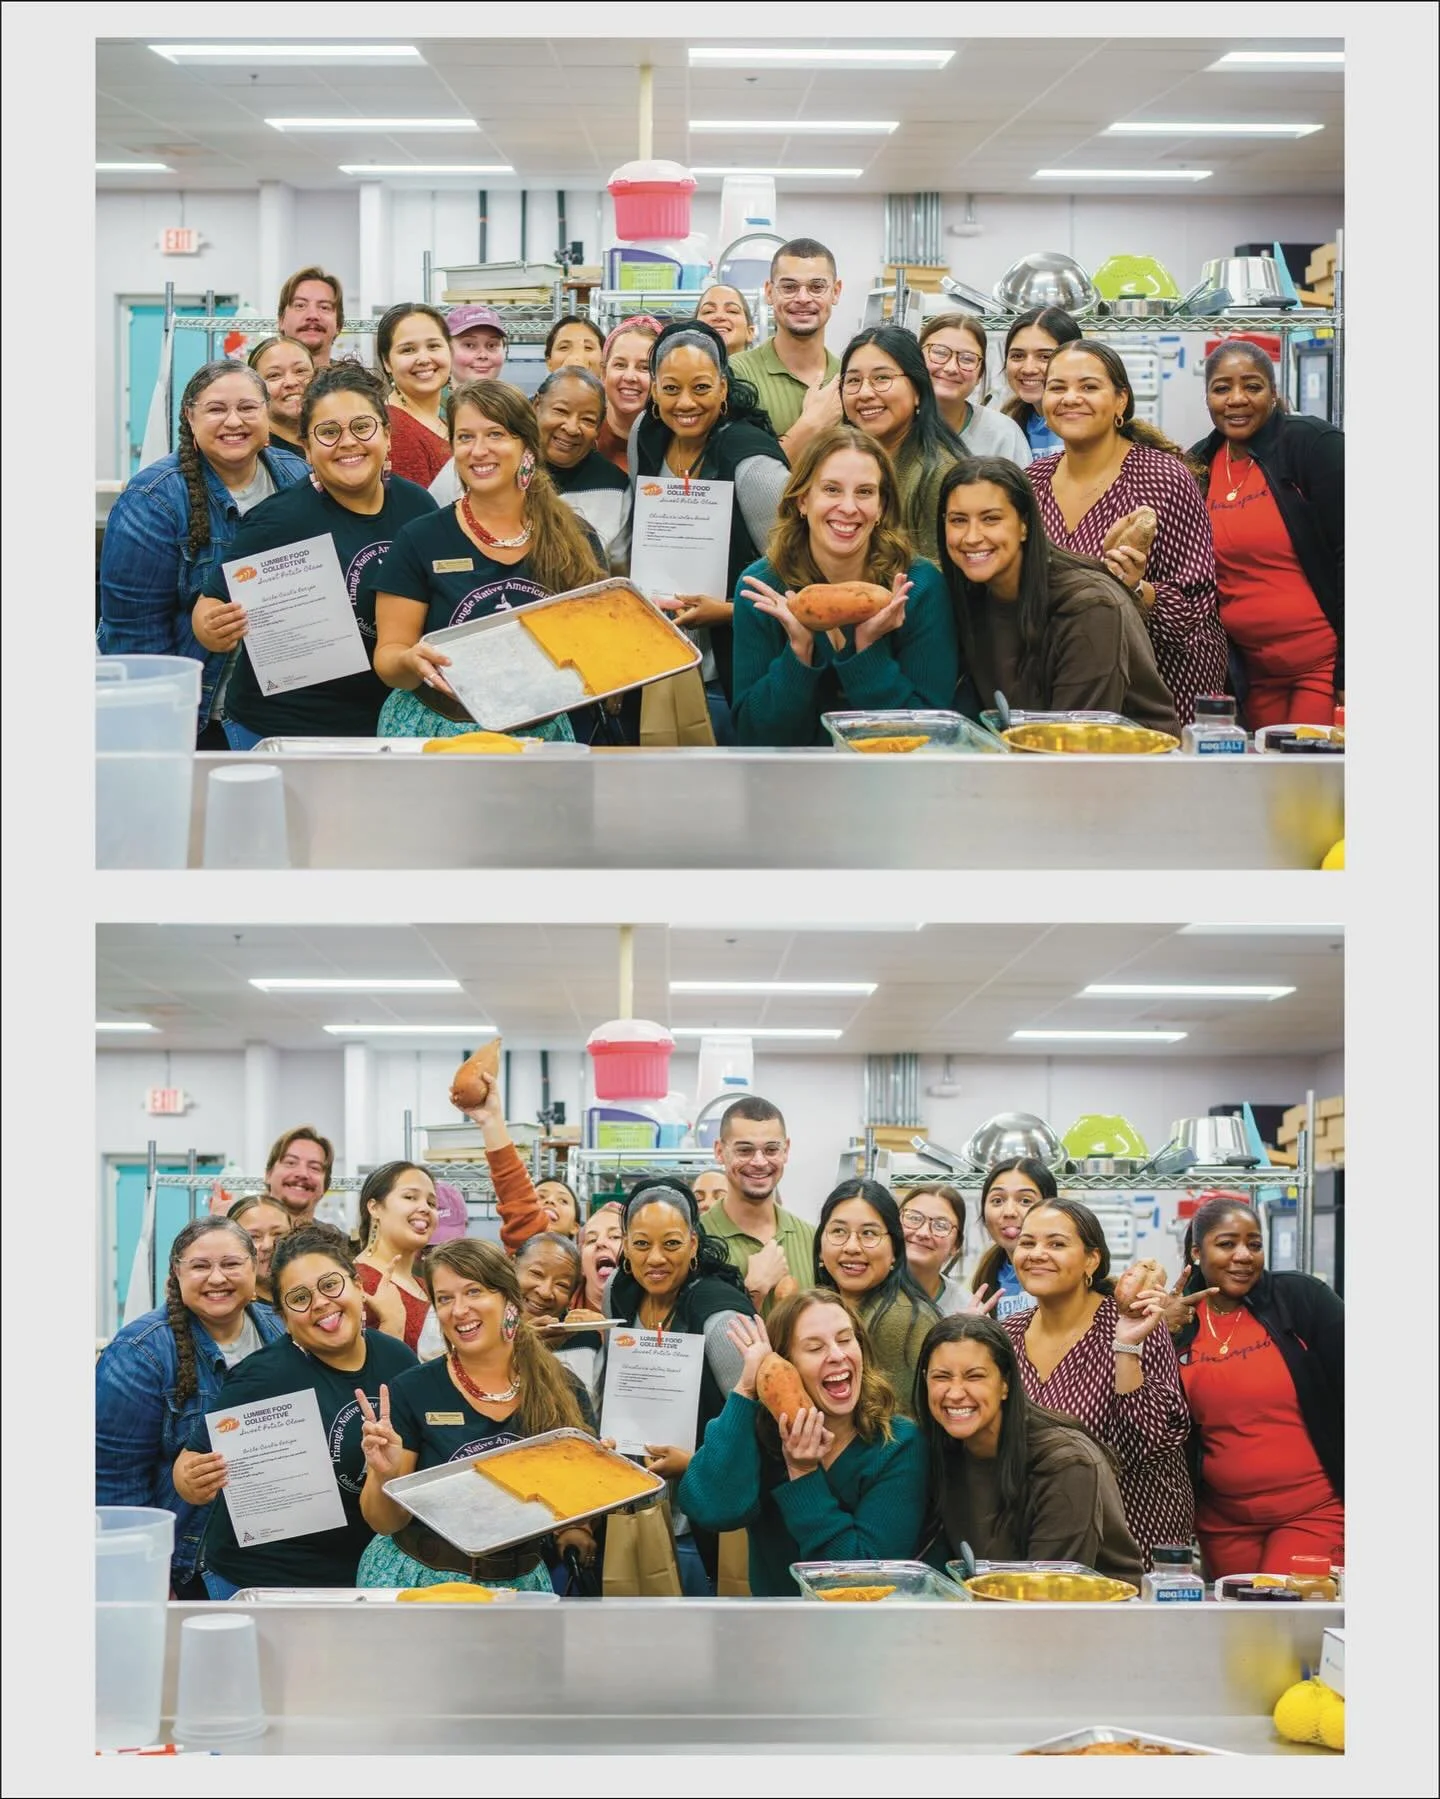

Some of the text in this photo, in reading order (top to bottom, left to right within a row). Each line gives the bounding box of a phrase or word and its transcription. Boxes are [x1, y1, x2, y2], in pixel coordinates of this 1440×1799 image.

[166, 229, 192, 250] EXIT
[260, 549, 310, 568] LUMBEE FOOD
[262, 557, 307, 574] COLLECTIVE
[355, 548, 378, 570] Native
[475, 585, 503, 603] Native
[1179, 1337, 1271, 1366] Champio
[243, 1403, 293, 1420] LUMBEE FOOD
[244, 1410, 289, 1426] COLLECTIVE
[337, 1406, 360, 1427] Native
[464, 1440, 494, 1456] Native
